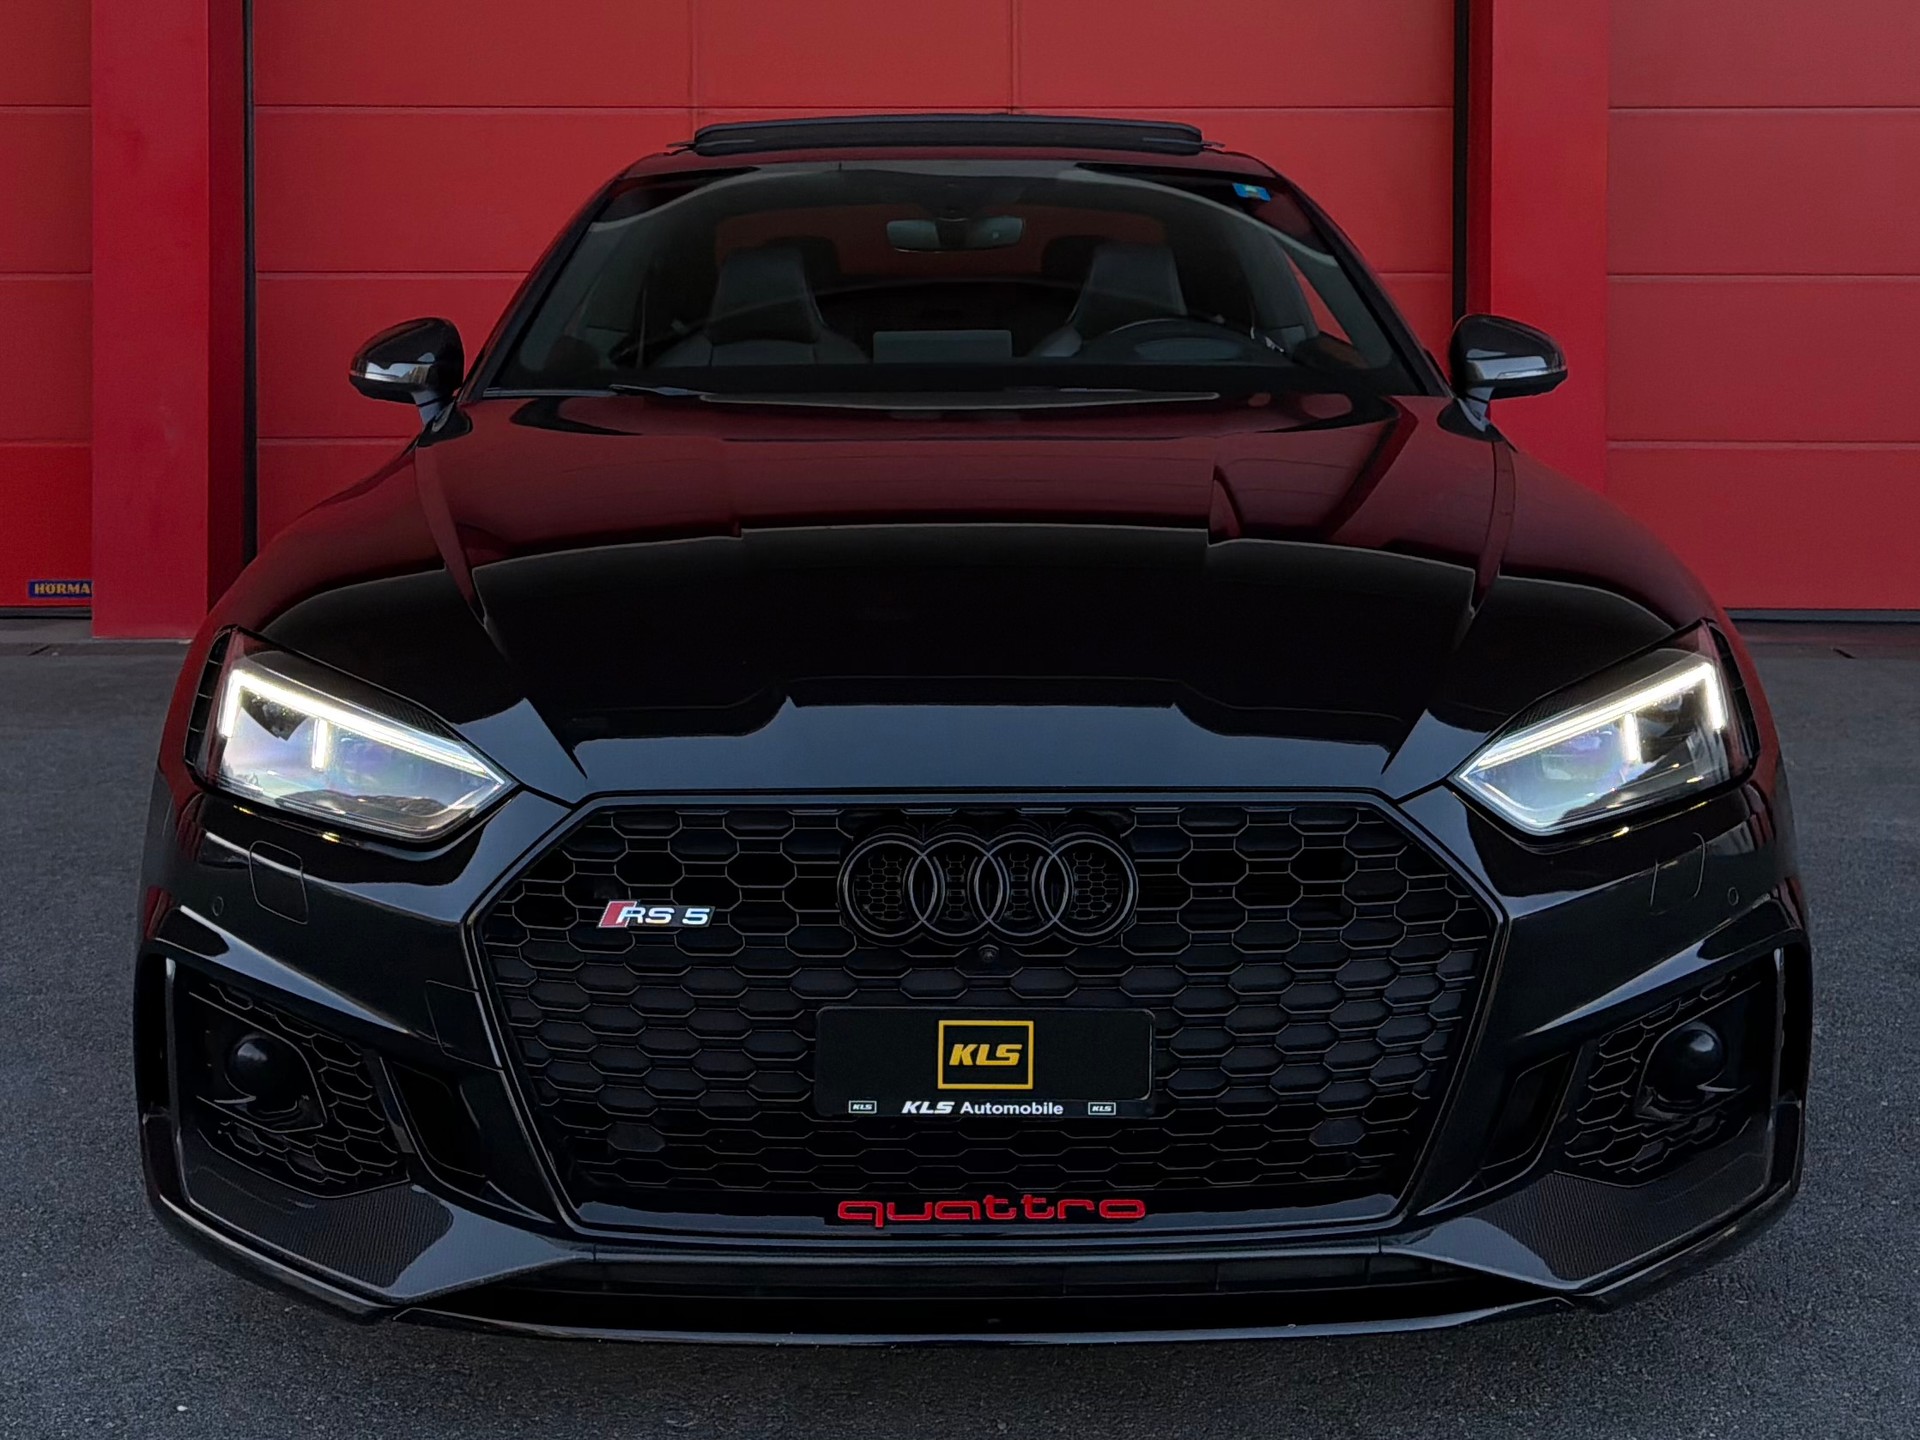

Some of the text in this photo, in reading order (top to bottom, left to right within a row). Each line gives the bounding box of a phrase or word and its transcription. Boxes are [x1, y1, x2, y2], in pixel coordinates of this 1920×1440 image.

[616, 906, 710, 925] RS 5
[949, 1044, 1023, 1066] KLS
[851, 1103, 873, 1111] KLS
[901, 1100, 1064, 1115] KLS Automobile
[1091, 1105, 1113, 1113] KLS
[838, 1194, 1146, 1228] quattro
